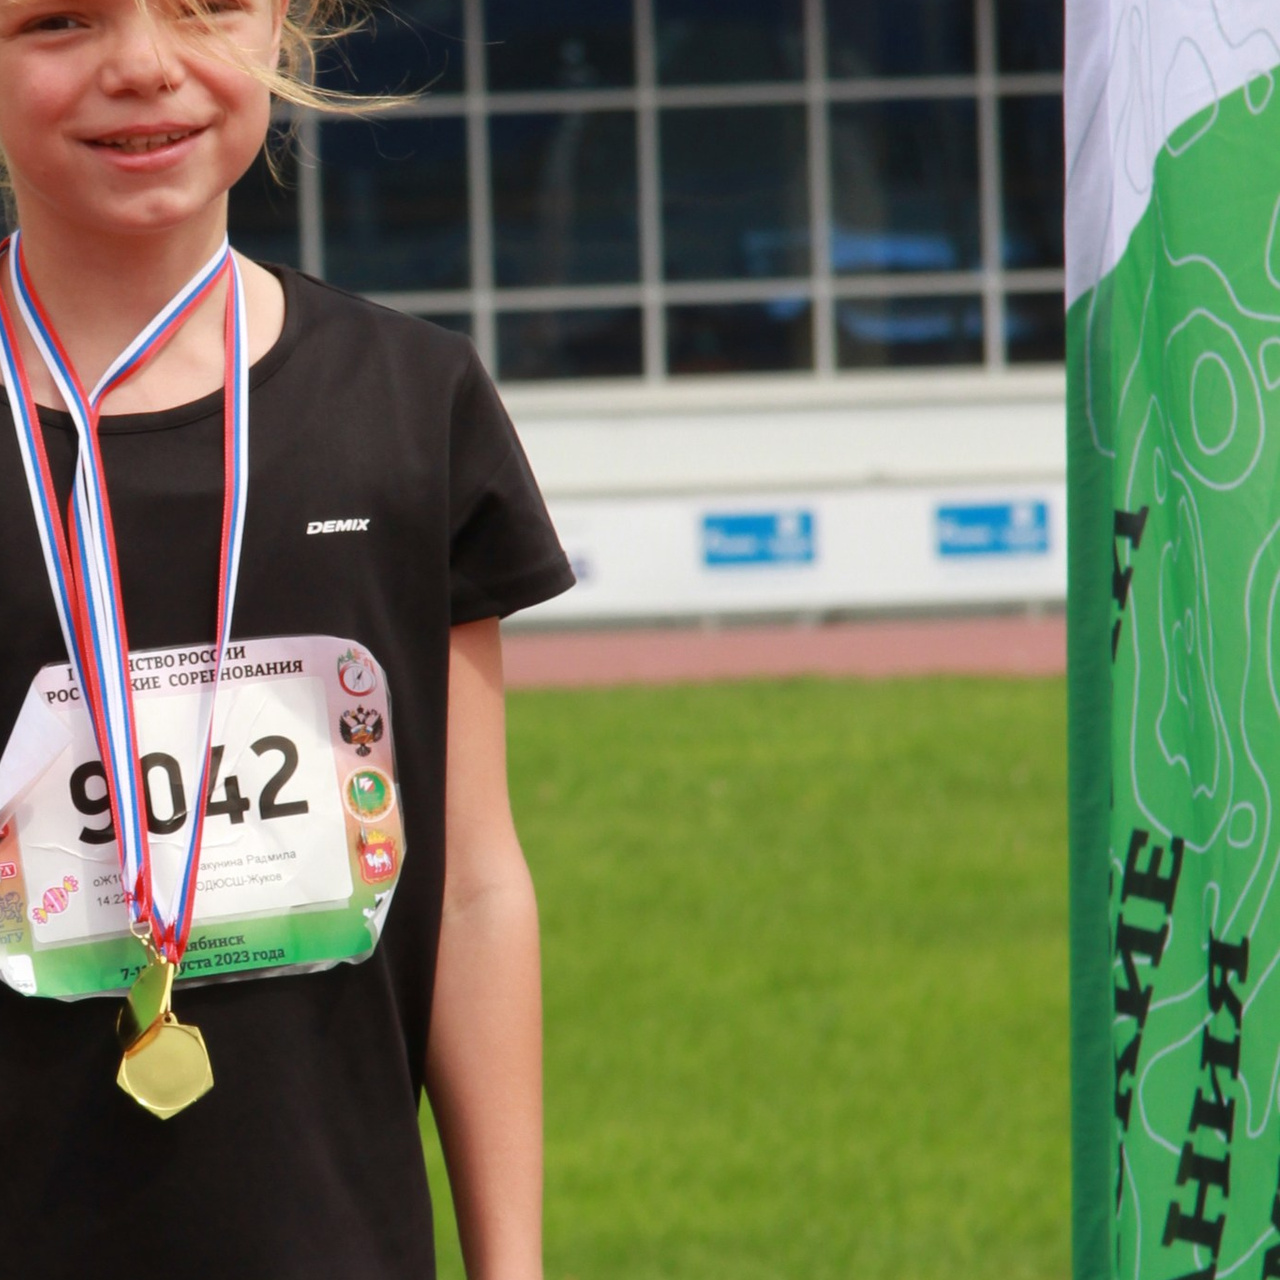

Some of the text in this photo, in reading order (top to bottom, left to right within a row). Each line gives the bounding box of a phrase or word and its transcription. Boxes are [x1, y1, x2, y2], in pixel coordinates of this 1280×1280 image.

[306, 518, 370, 535] DEMIX
[70, 735, 309, 845] 9042
[199, 858, 243, 871] акунина
[246, 850, 297, 865] Радмила
[215, 950, 250, 968] 2023
[253, 948, 286, 963] года
